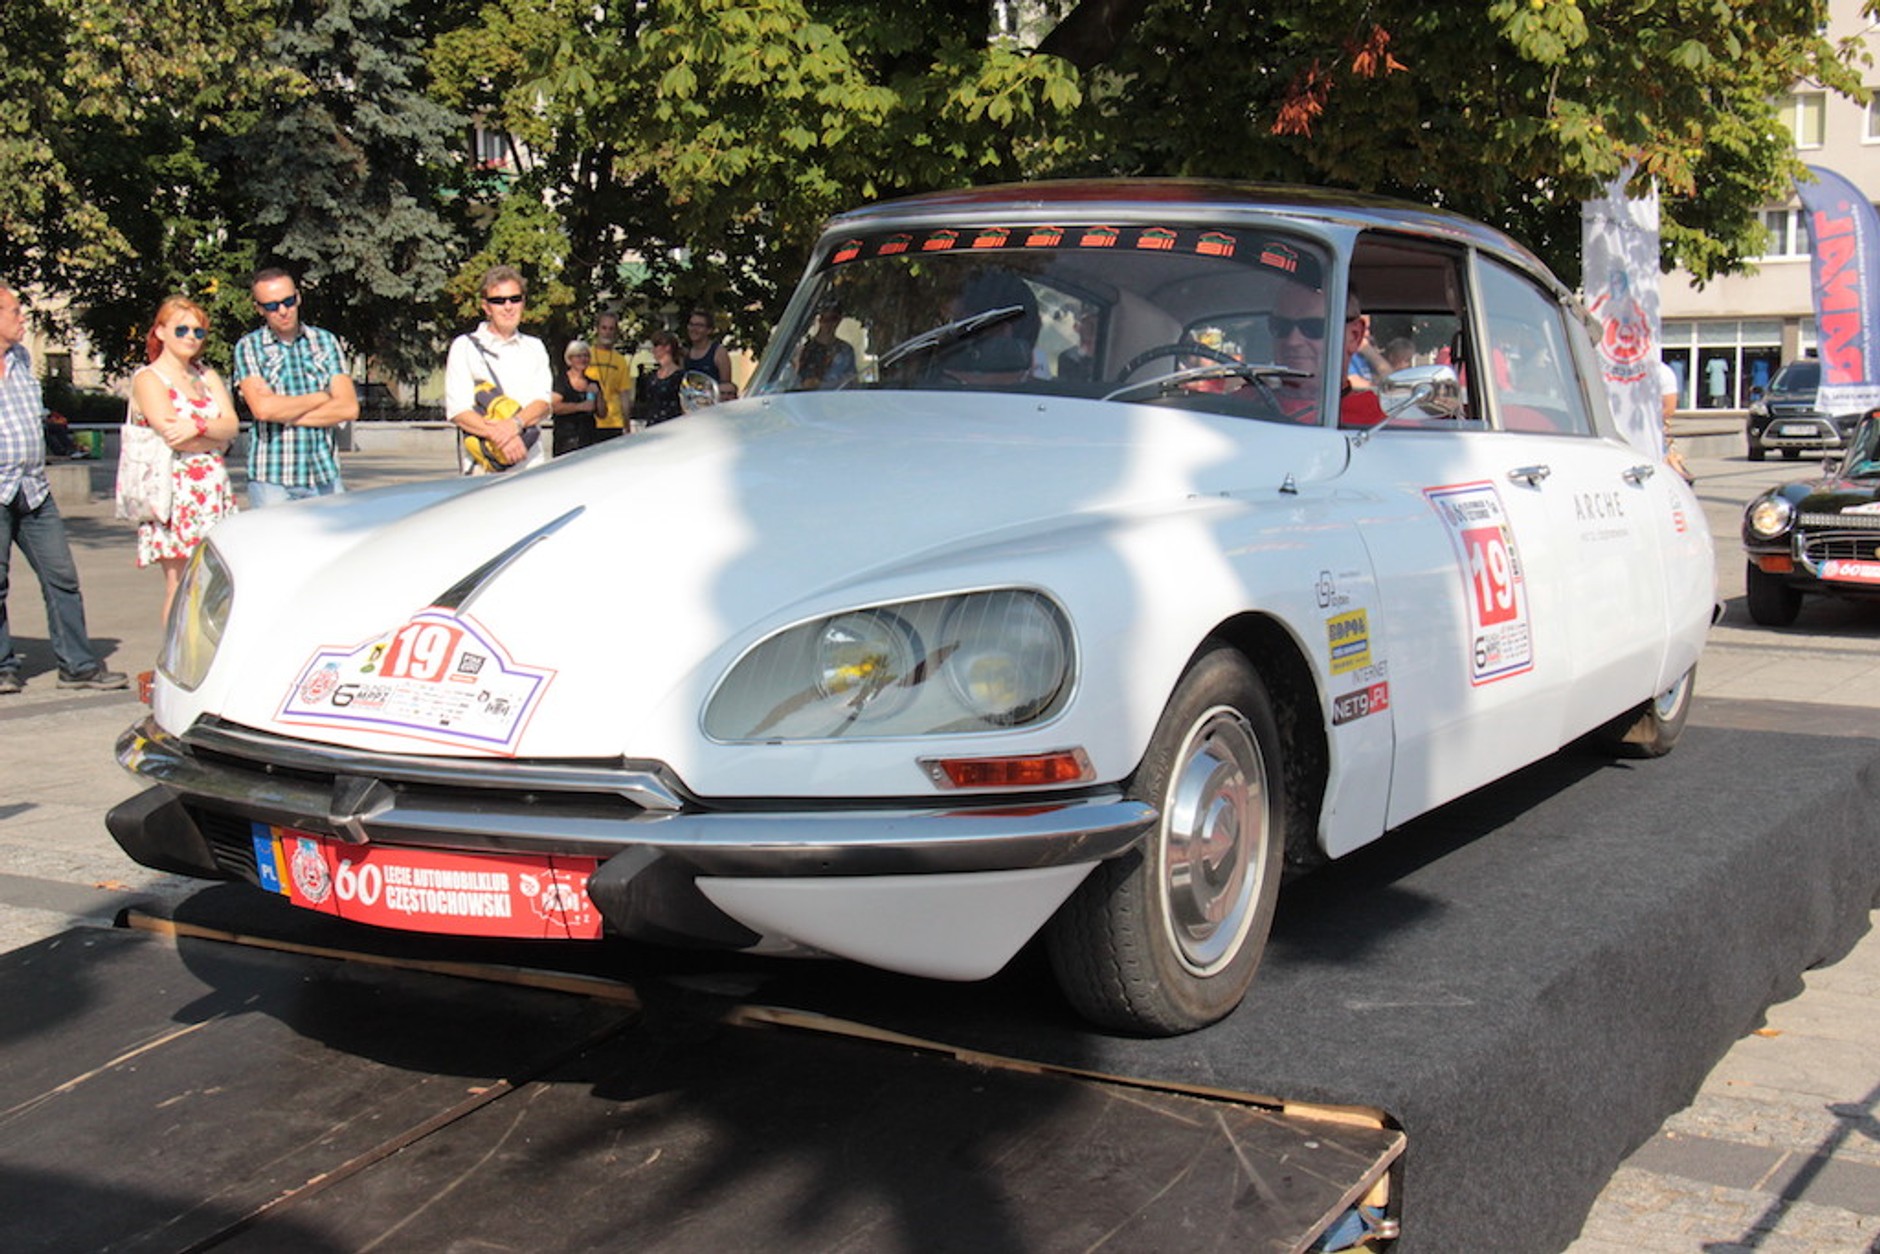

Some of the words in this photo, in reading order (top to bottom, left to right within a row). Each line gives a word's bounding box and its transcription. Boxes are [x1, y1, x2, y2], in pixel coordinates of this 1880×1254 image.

[1574, 491, 1624, 520] ARCHE
[1471, 539, 1513, 613] 19
[393, 623, 452, 681] 19
[331, 683, 361, 707] 6
[1333, 685, 1388, 722] NET9.PL
[260, 863, 278, 881] PL
[335, 858, 383, 907] 60
[383, 864, 413, 886] LECIE
[412, 867, 510, 892] AUTOMOBILKLUB
[385, 884, 513, 918] CZĘSTOCHOWSKI
